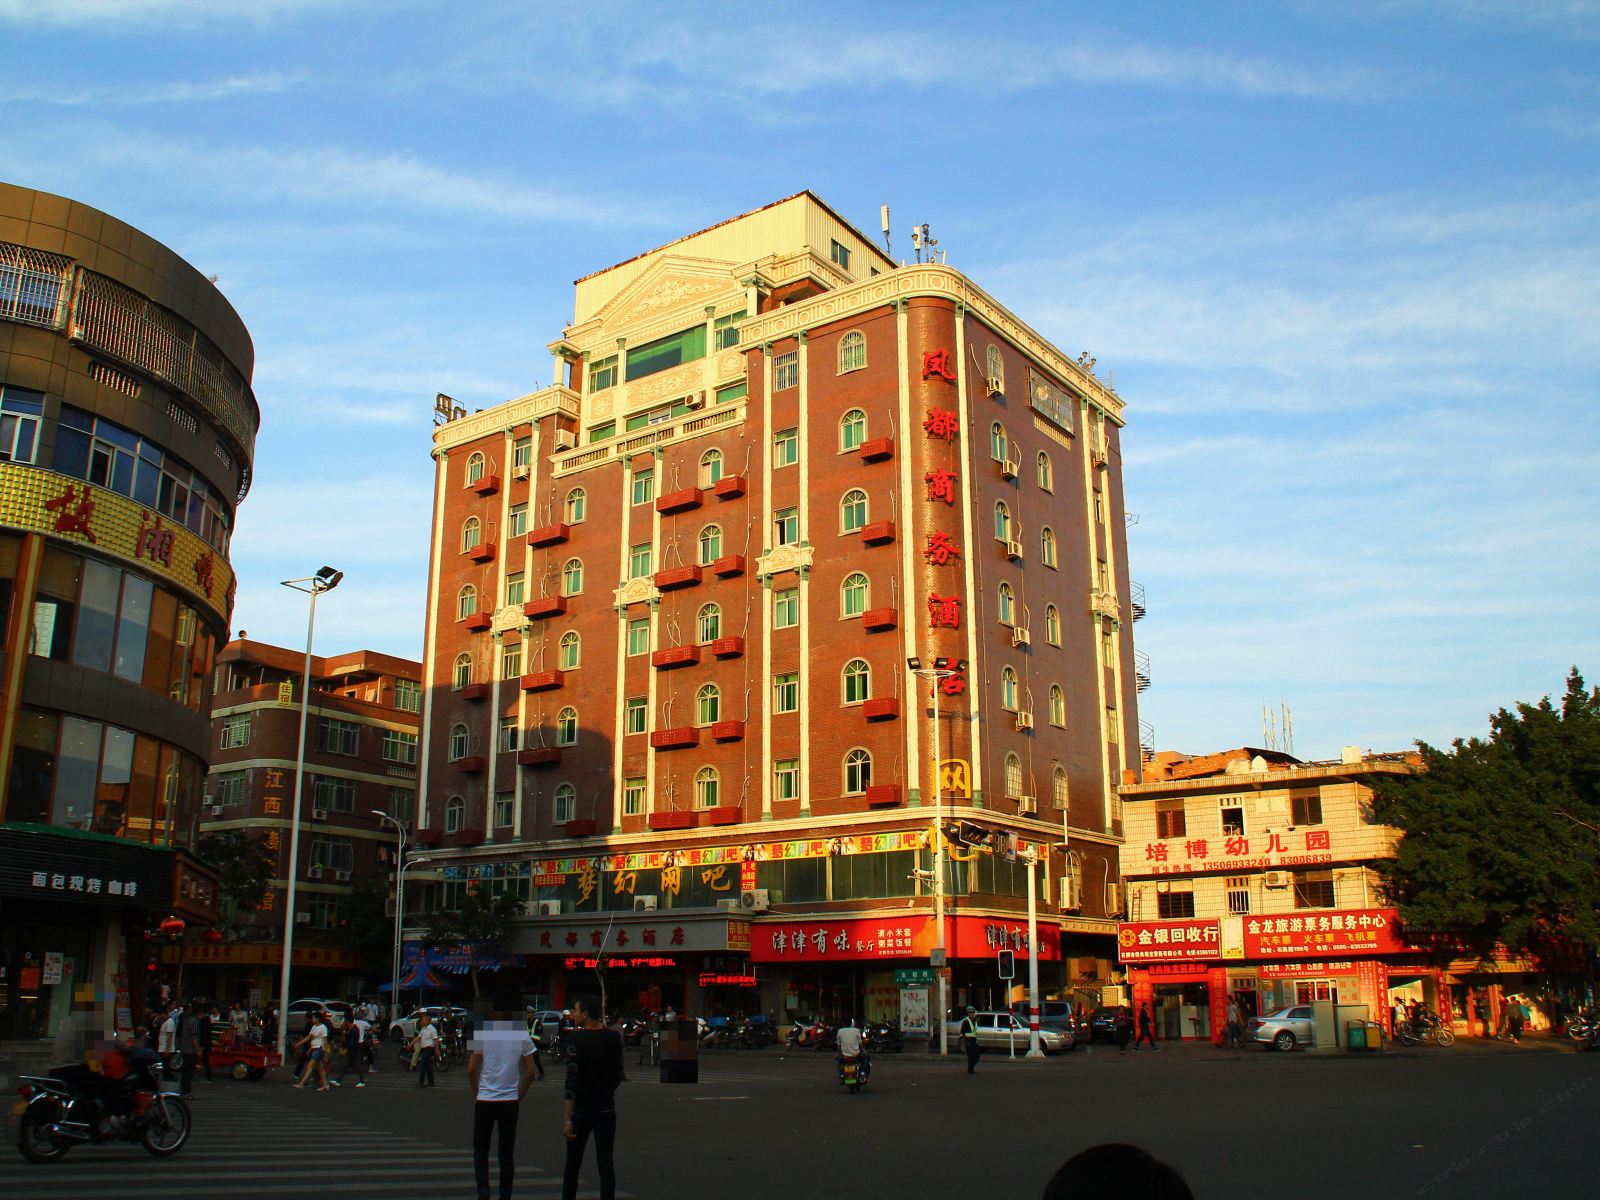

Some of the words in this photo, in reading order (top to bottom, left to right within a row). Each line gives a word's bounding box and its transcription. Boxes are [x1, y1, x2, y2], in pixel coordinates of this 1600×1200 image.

[772, 841, 824, 859] 梦幻网吧
[860, 834, 917, 851] 梦幻网吧
[1144, 830, 1331, 863] 培博幼儿园
[615, 854, 660, 869] 梦幻网吧
[690, 848, 738, 865] 梦幻网吧
[1202, 857, 1271, 872] 13506933240
[1280, 853, 1332, 866] 83006839
[32, 871, 102, 894] 面包现烤
[575, 865, 731, 906] 梦幻网吧
[1248, 913, 1387, 935] 金龙旅游票务服务中心
[772, 927, 851, 955] 津津有味
[1138, 926, 1218, 945] 金银回收行
[1260, 934, 1292, 946] 汽车票
[1303, 933, 1335, 944] 火车票
[1344, 931, 1377, 942] 飞机票
